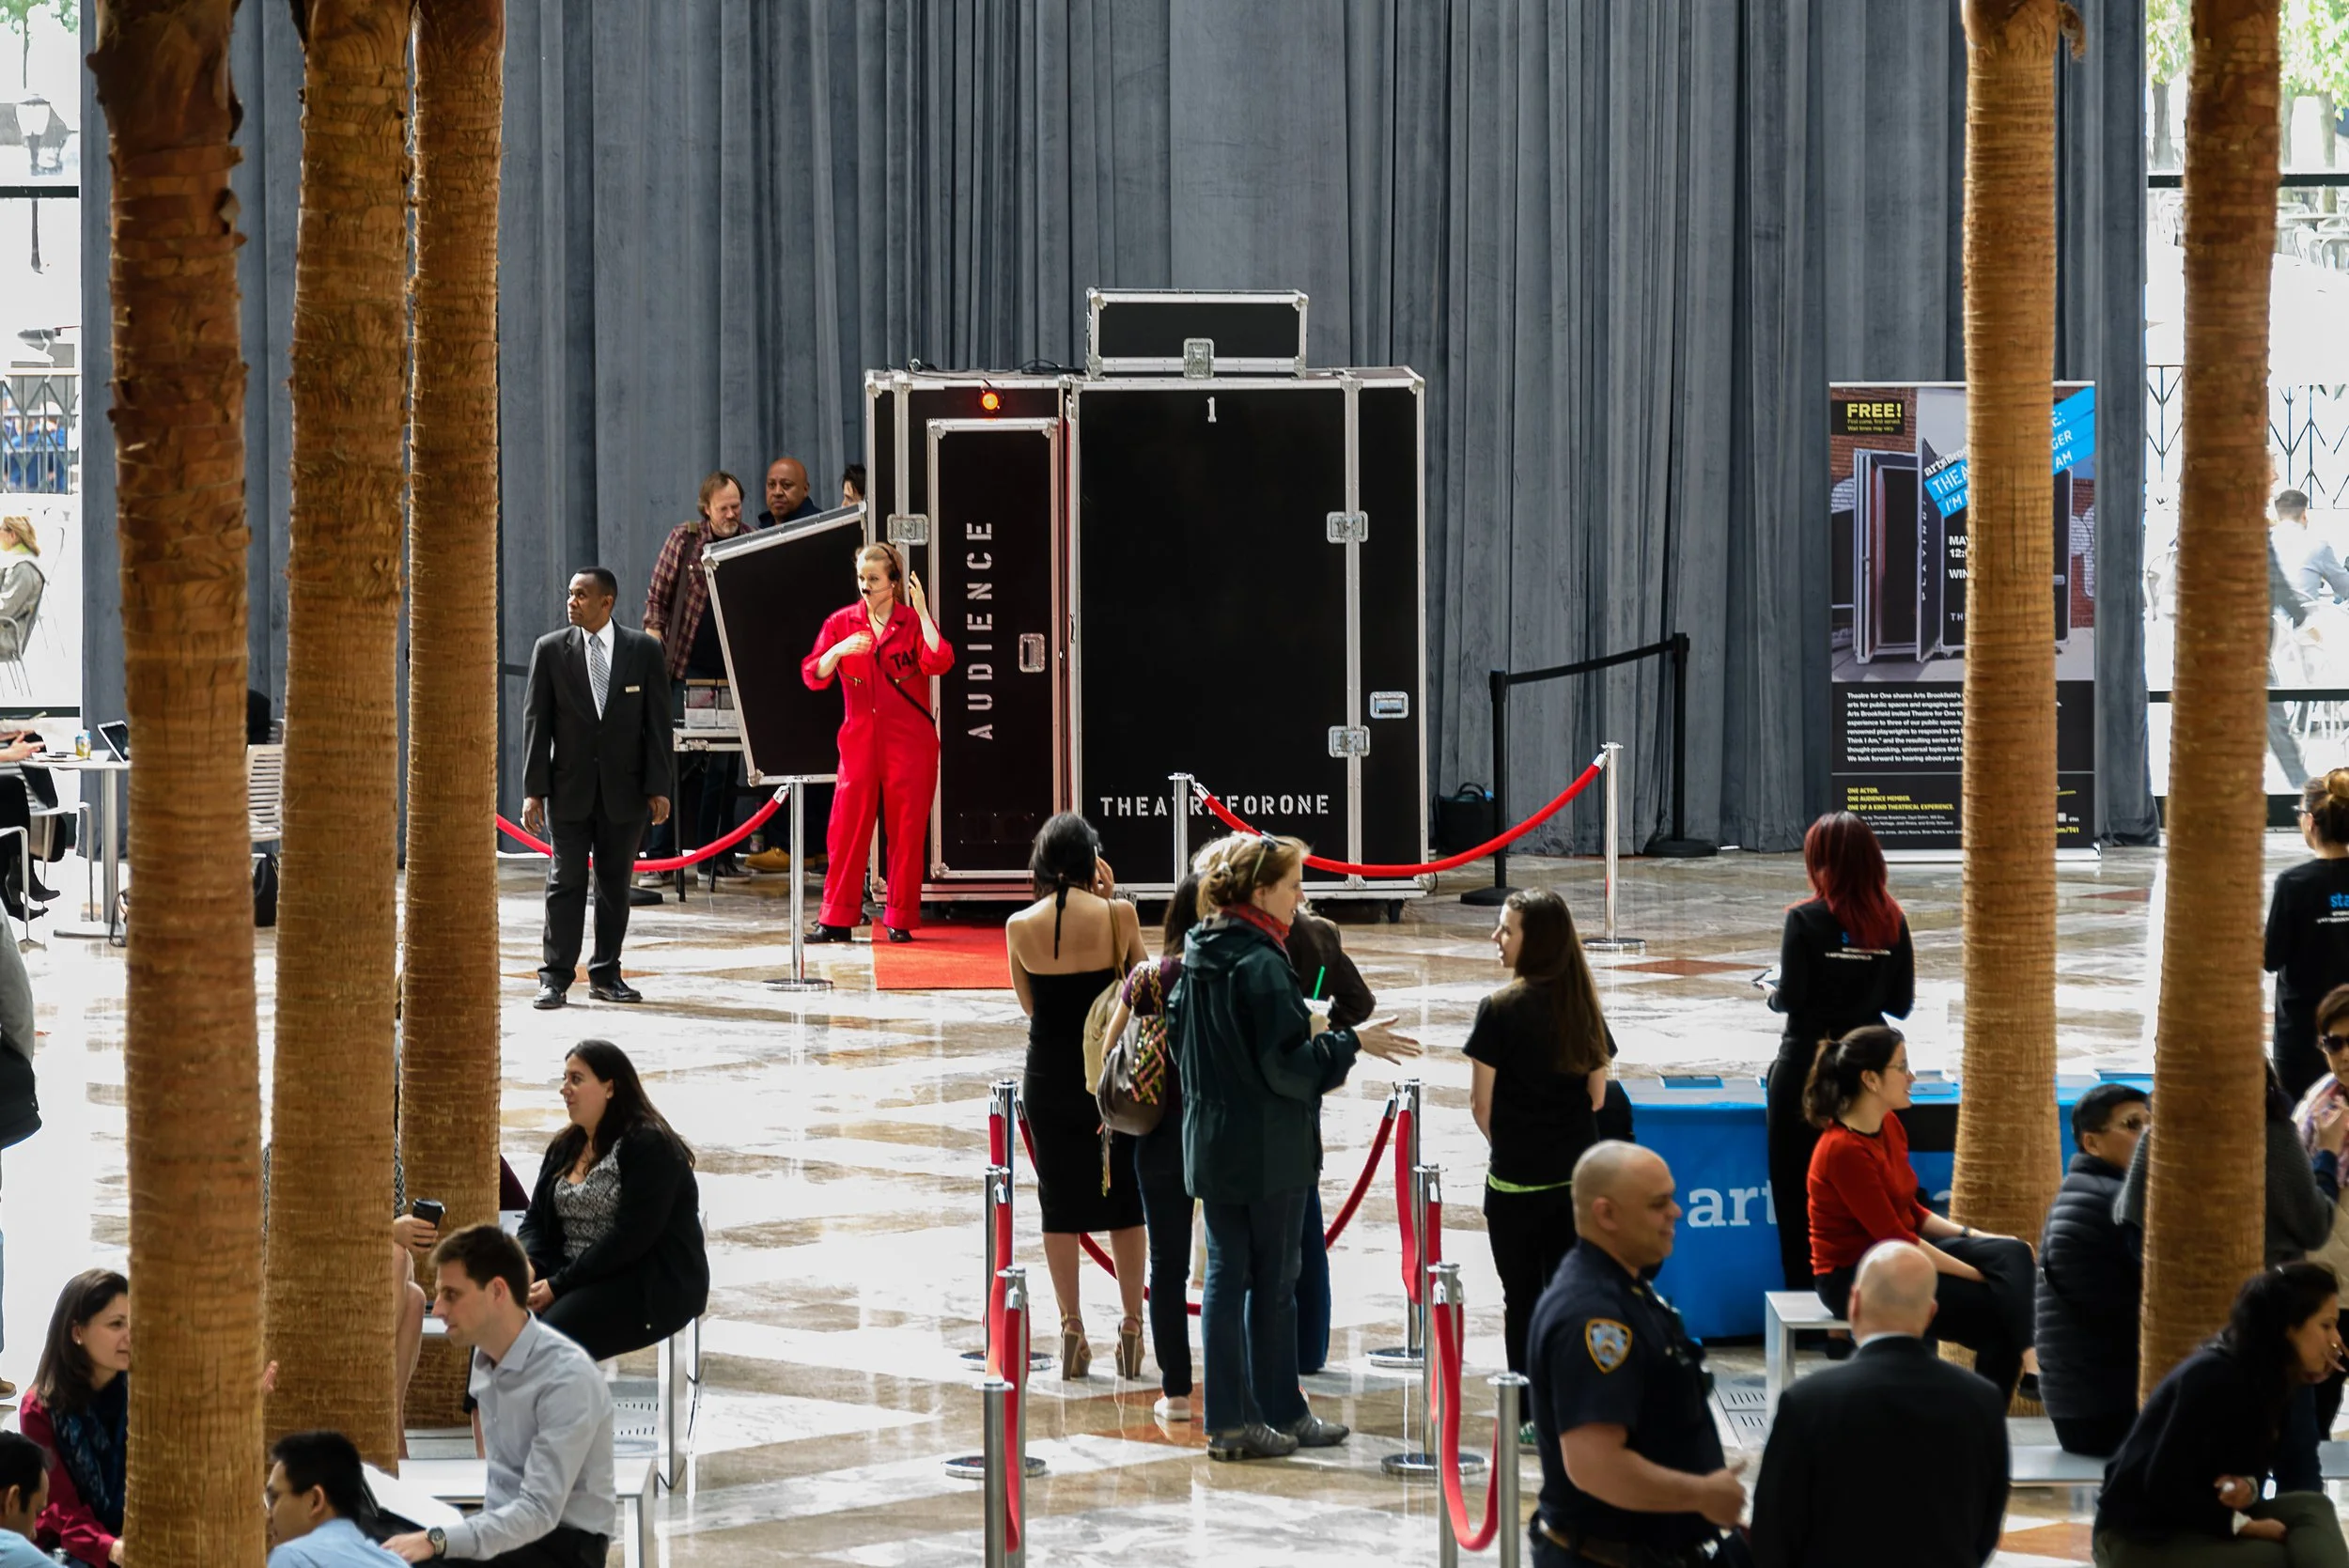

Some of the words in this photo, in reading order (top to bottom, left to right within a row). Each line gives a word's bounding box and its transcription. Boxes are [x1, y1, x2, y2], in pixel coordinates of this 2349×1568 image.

[1207, 396, 1217, 423] 1
[1847, 403, 1902, 418] FREE!
[2056, 450, 2073, 469] AM
[1946, 494, 1963, 512] I'M
[966, 522, 993, 740] AUDIENCE
[1100, 795, 1329, 816] THEARFORONE
